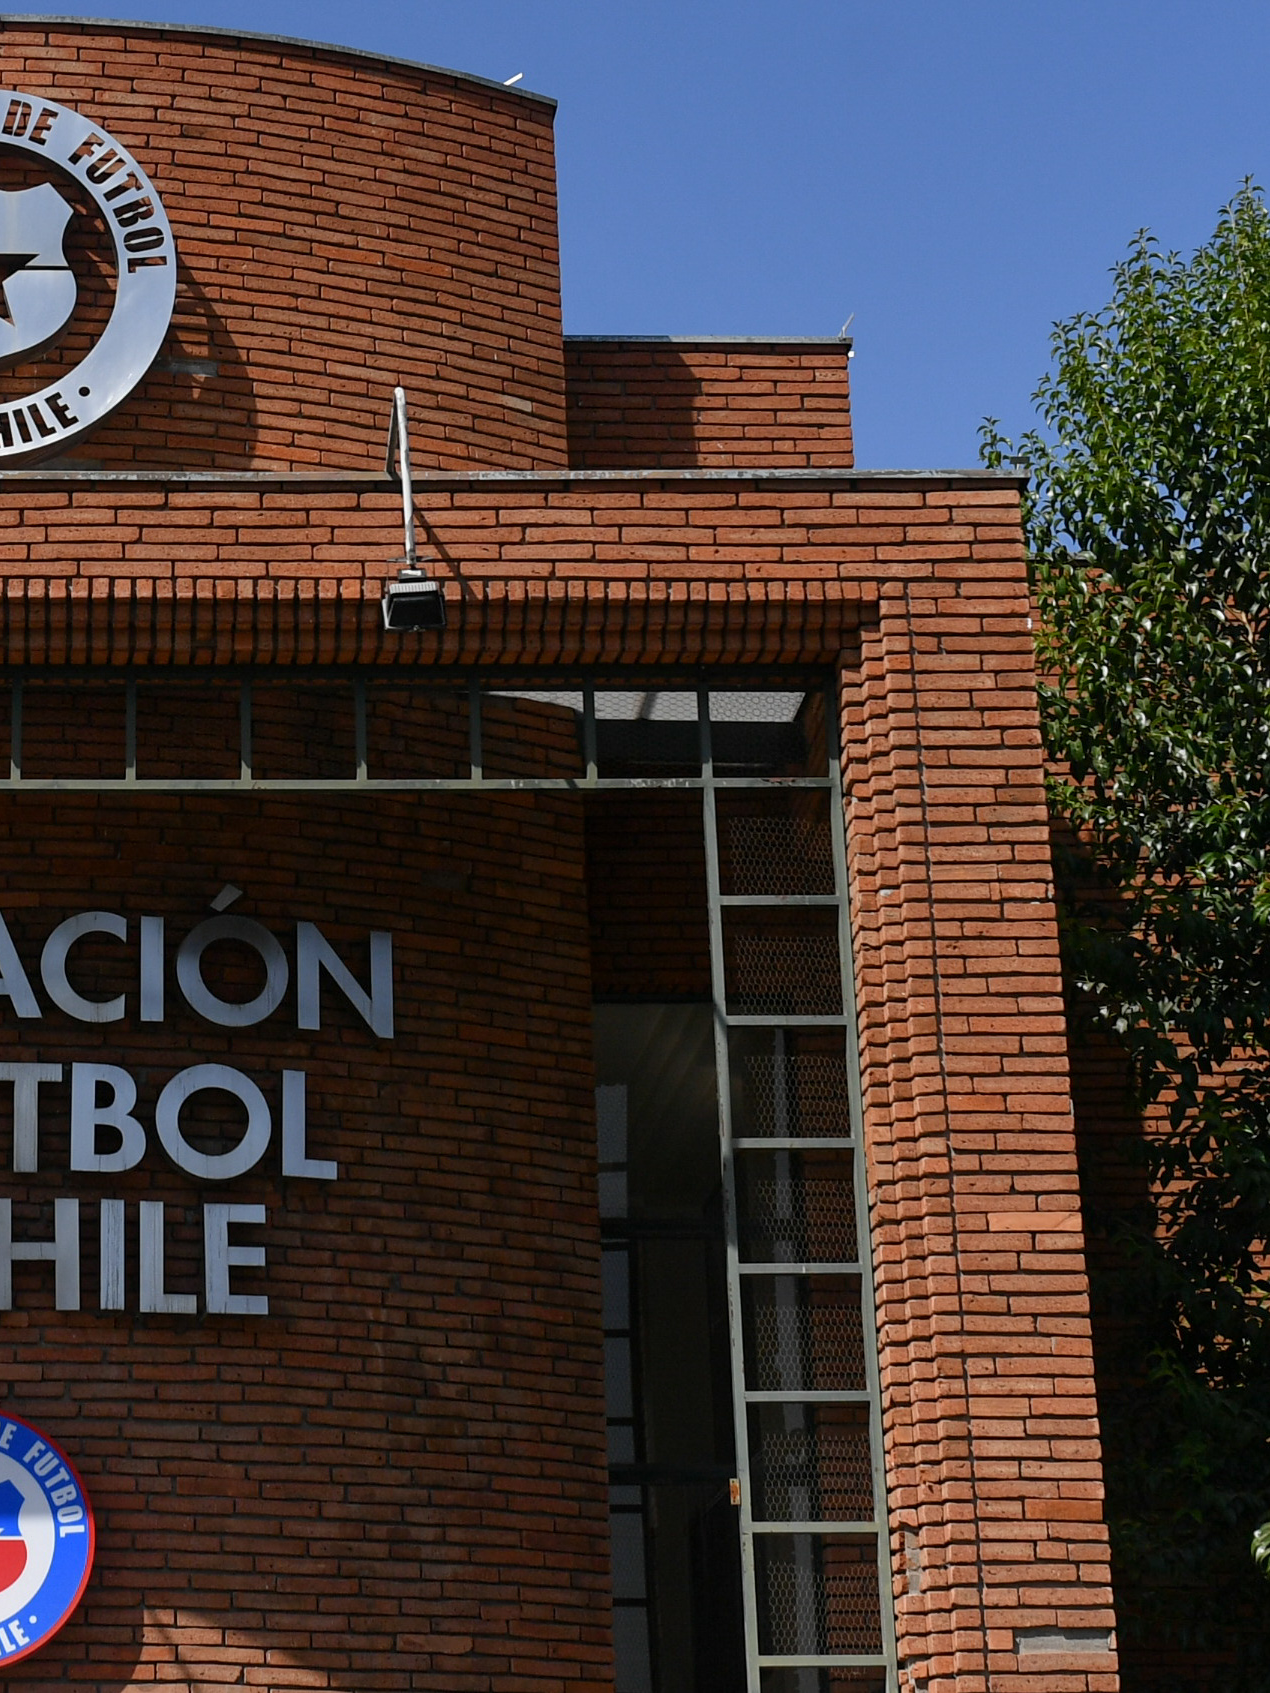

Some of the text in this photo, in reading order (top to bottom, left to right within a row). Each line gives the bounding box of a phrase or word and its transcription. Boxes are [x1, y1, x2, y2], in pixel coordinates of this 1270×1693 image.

[1, 98, 59, 146] DE
[67, 132, 169, 274] FUTBOL
[22, 1441, 85, 1538] FUTBOL
